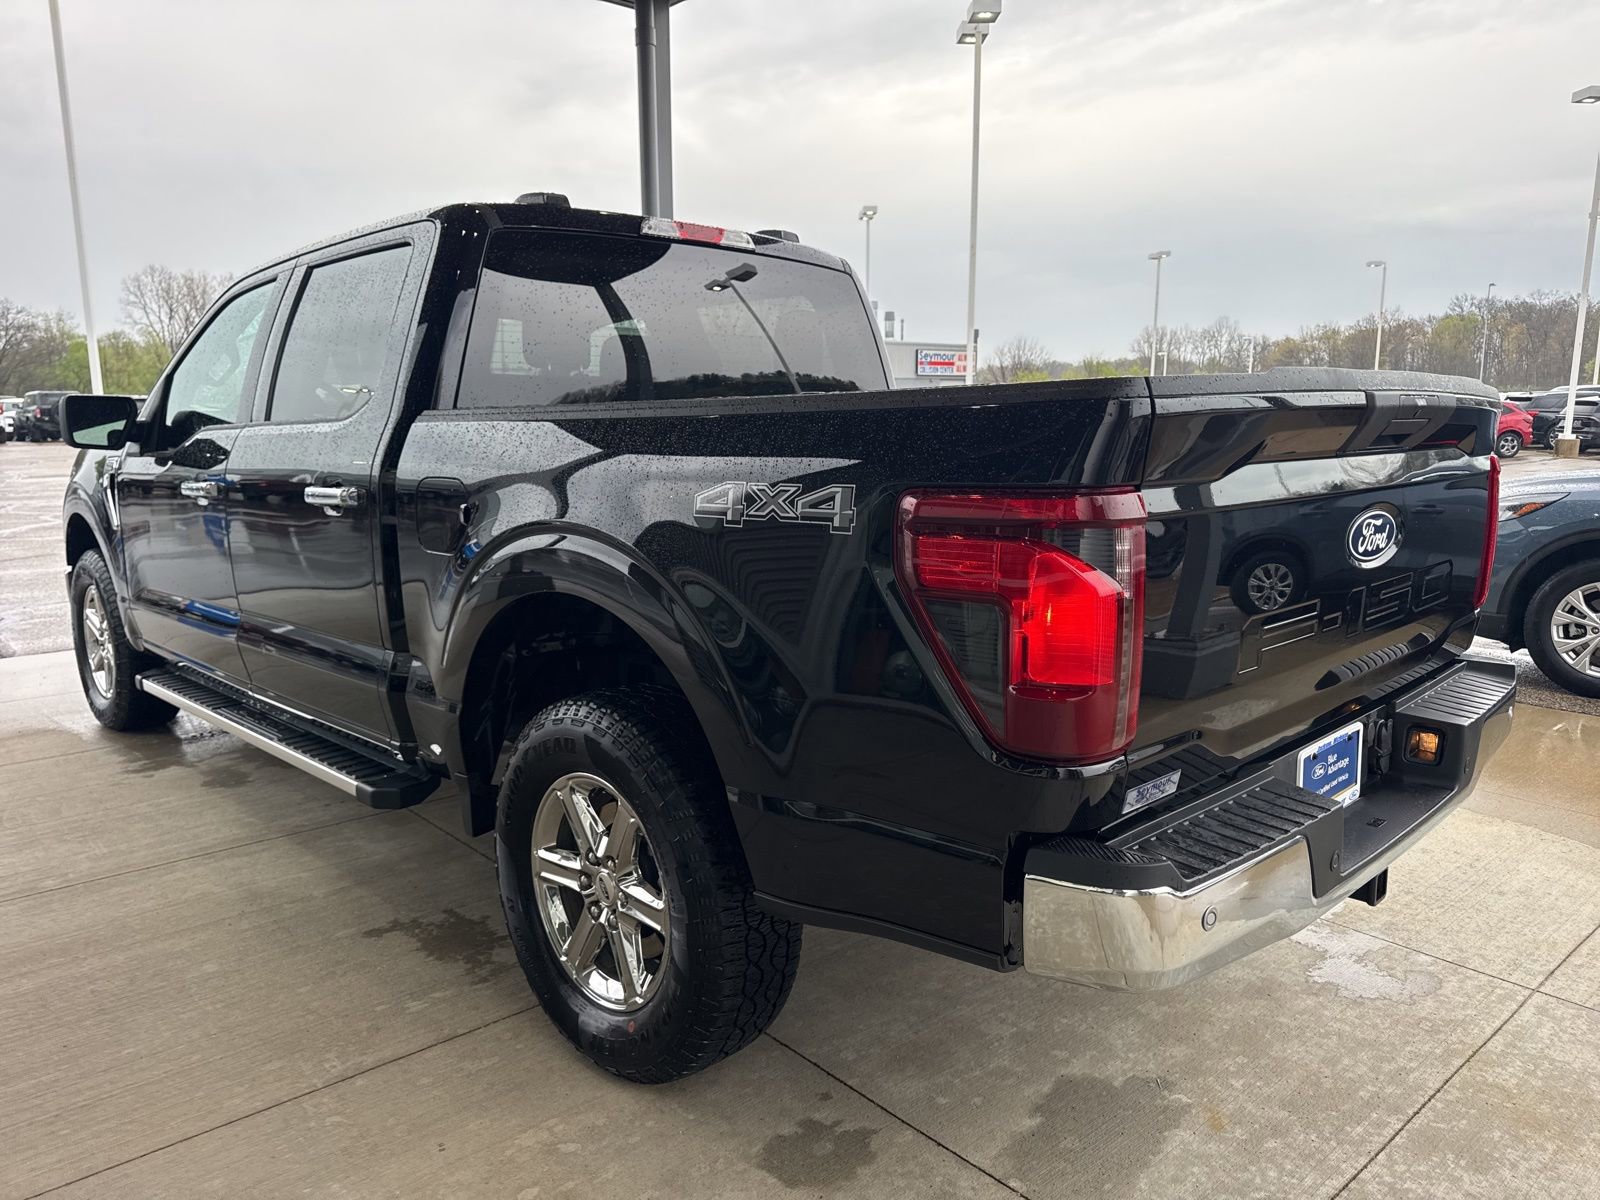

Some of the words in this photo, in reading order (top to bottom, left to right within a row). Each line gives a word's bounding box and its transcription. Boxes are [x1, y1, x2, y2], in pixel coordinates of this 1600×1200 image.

[919, 351, 956, 361] Seymour
[1358, 518, 1389, 553] Ford
[1236, 560, 1454, 674] F-150
[1327, 753, 1338, 765] Blue
[1327, 757, 1350, 775] Advantage
